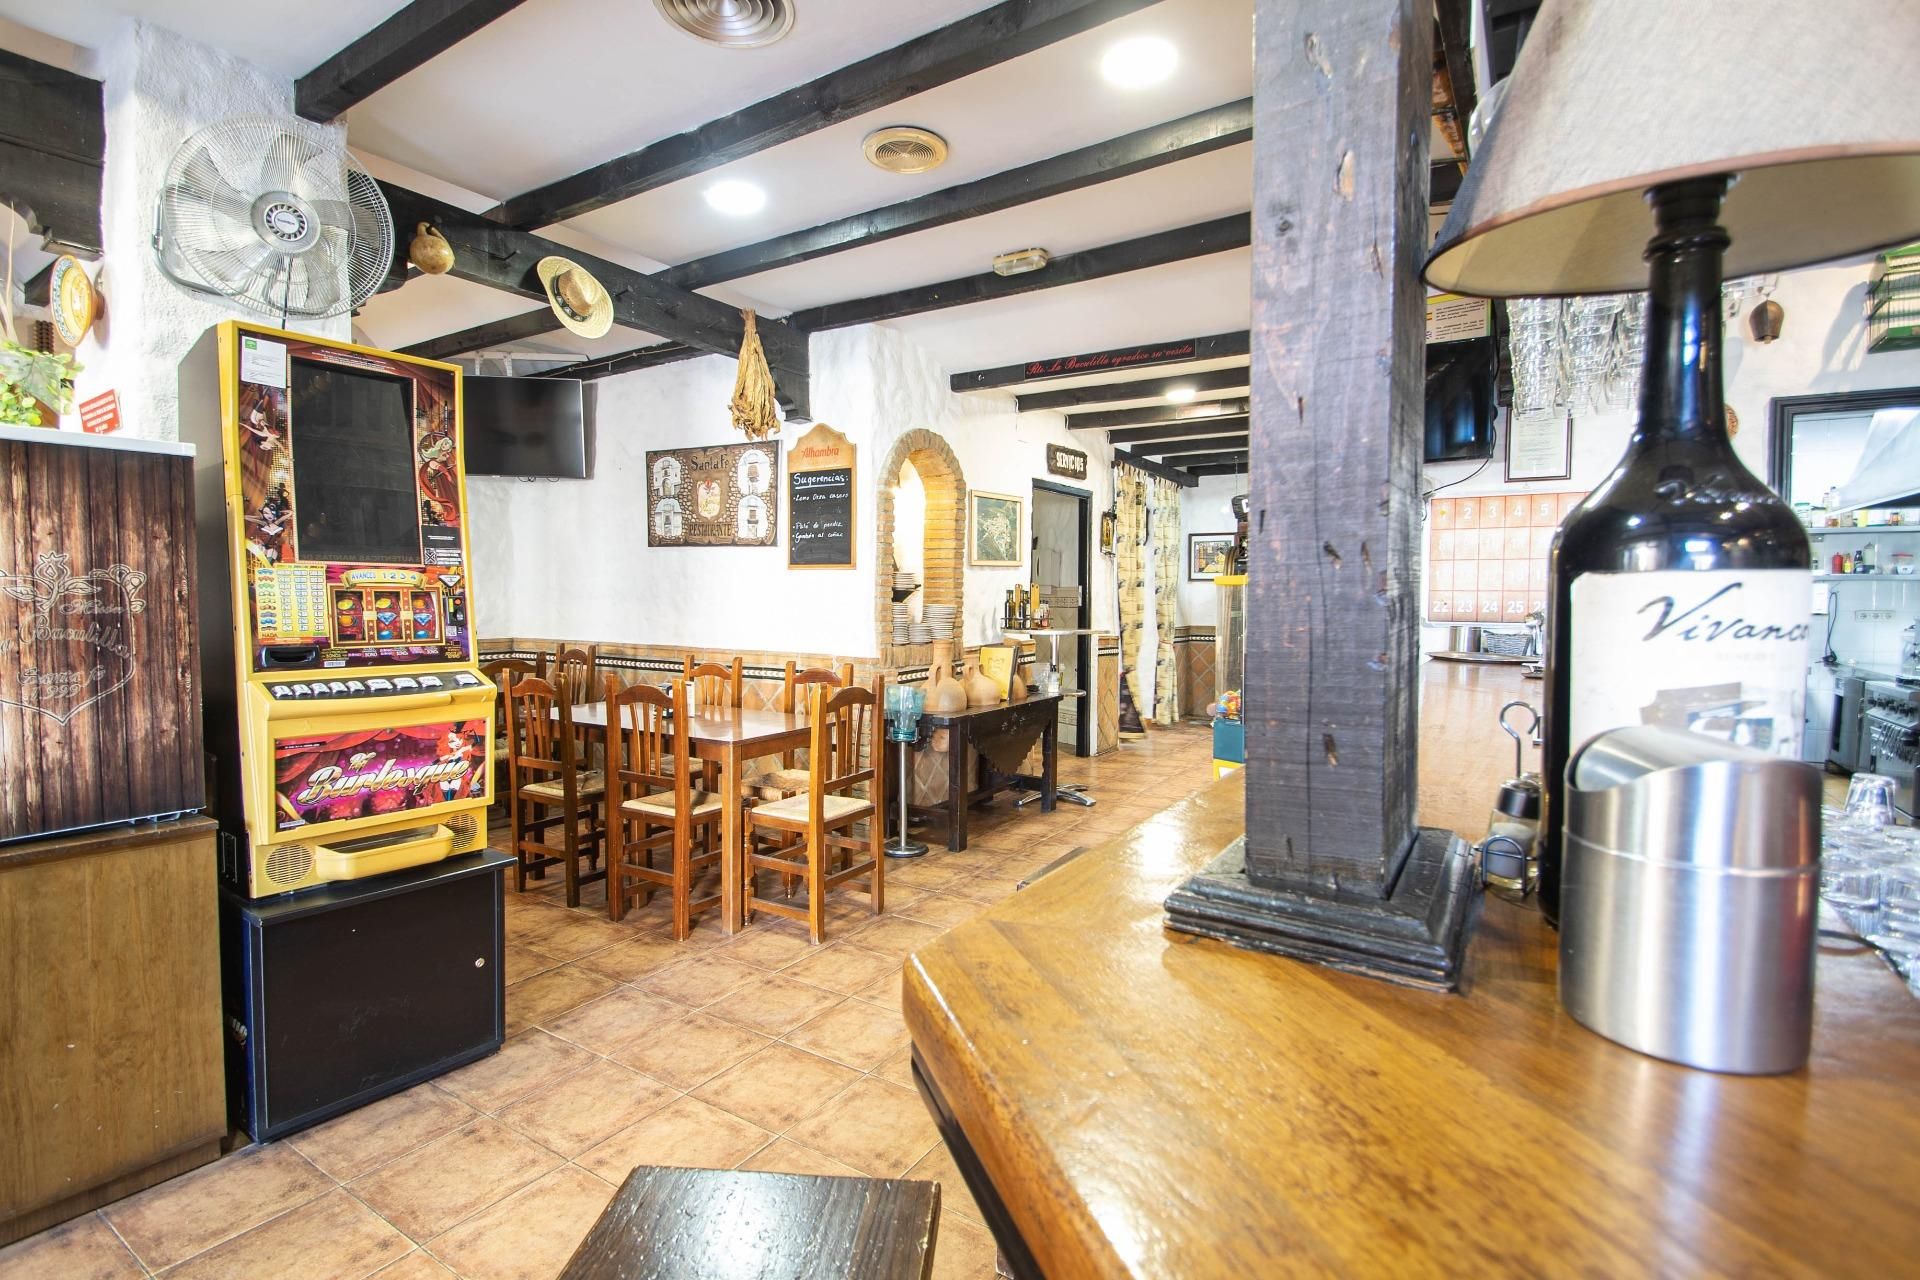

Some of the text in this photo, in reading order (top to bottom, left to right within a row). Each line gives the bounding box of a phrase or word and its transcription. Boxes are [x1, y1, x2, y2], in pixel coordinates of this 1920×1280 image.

[801, 446, 840, 458] Alhambra
[691, 456, 718, 472] Santa
[1056, 451, 1084, 472] SERVICIOS
[1464, 508, 1473, 519] 2
[1489, 507, 1497, 519] 3
[1513, 505, 1523, 517] 4
[1541, 503, 1549, 515] 5
[1433, 601, 1449, 613] 22
[1457, 601, 1473, 613] 23
[1482, 601, 1498, 613] 24
[1507, 602, 1524, 614] 25
[297, 758, 471, 806] Burlesque
